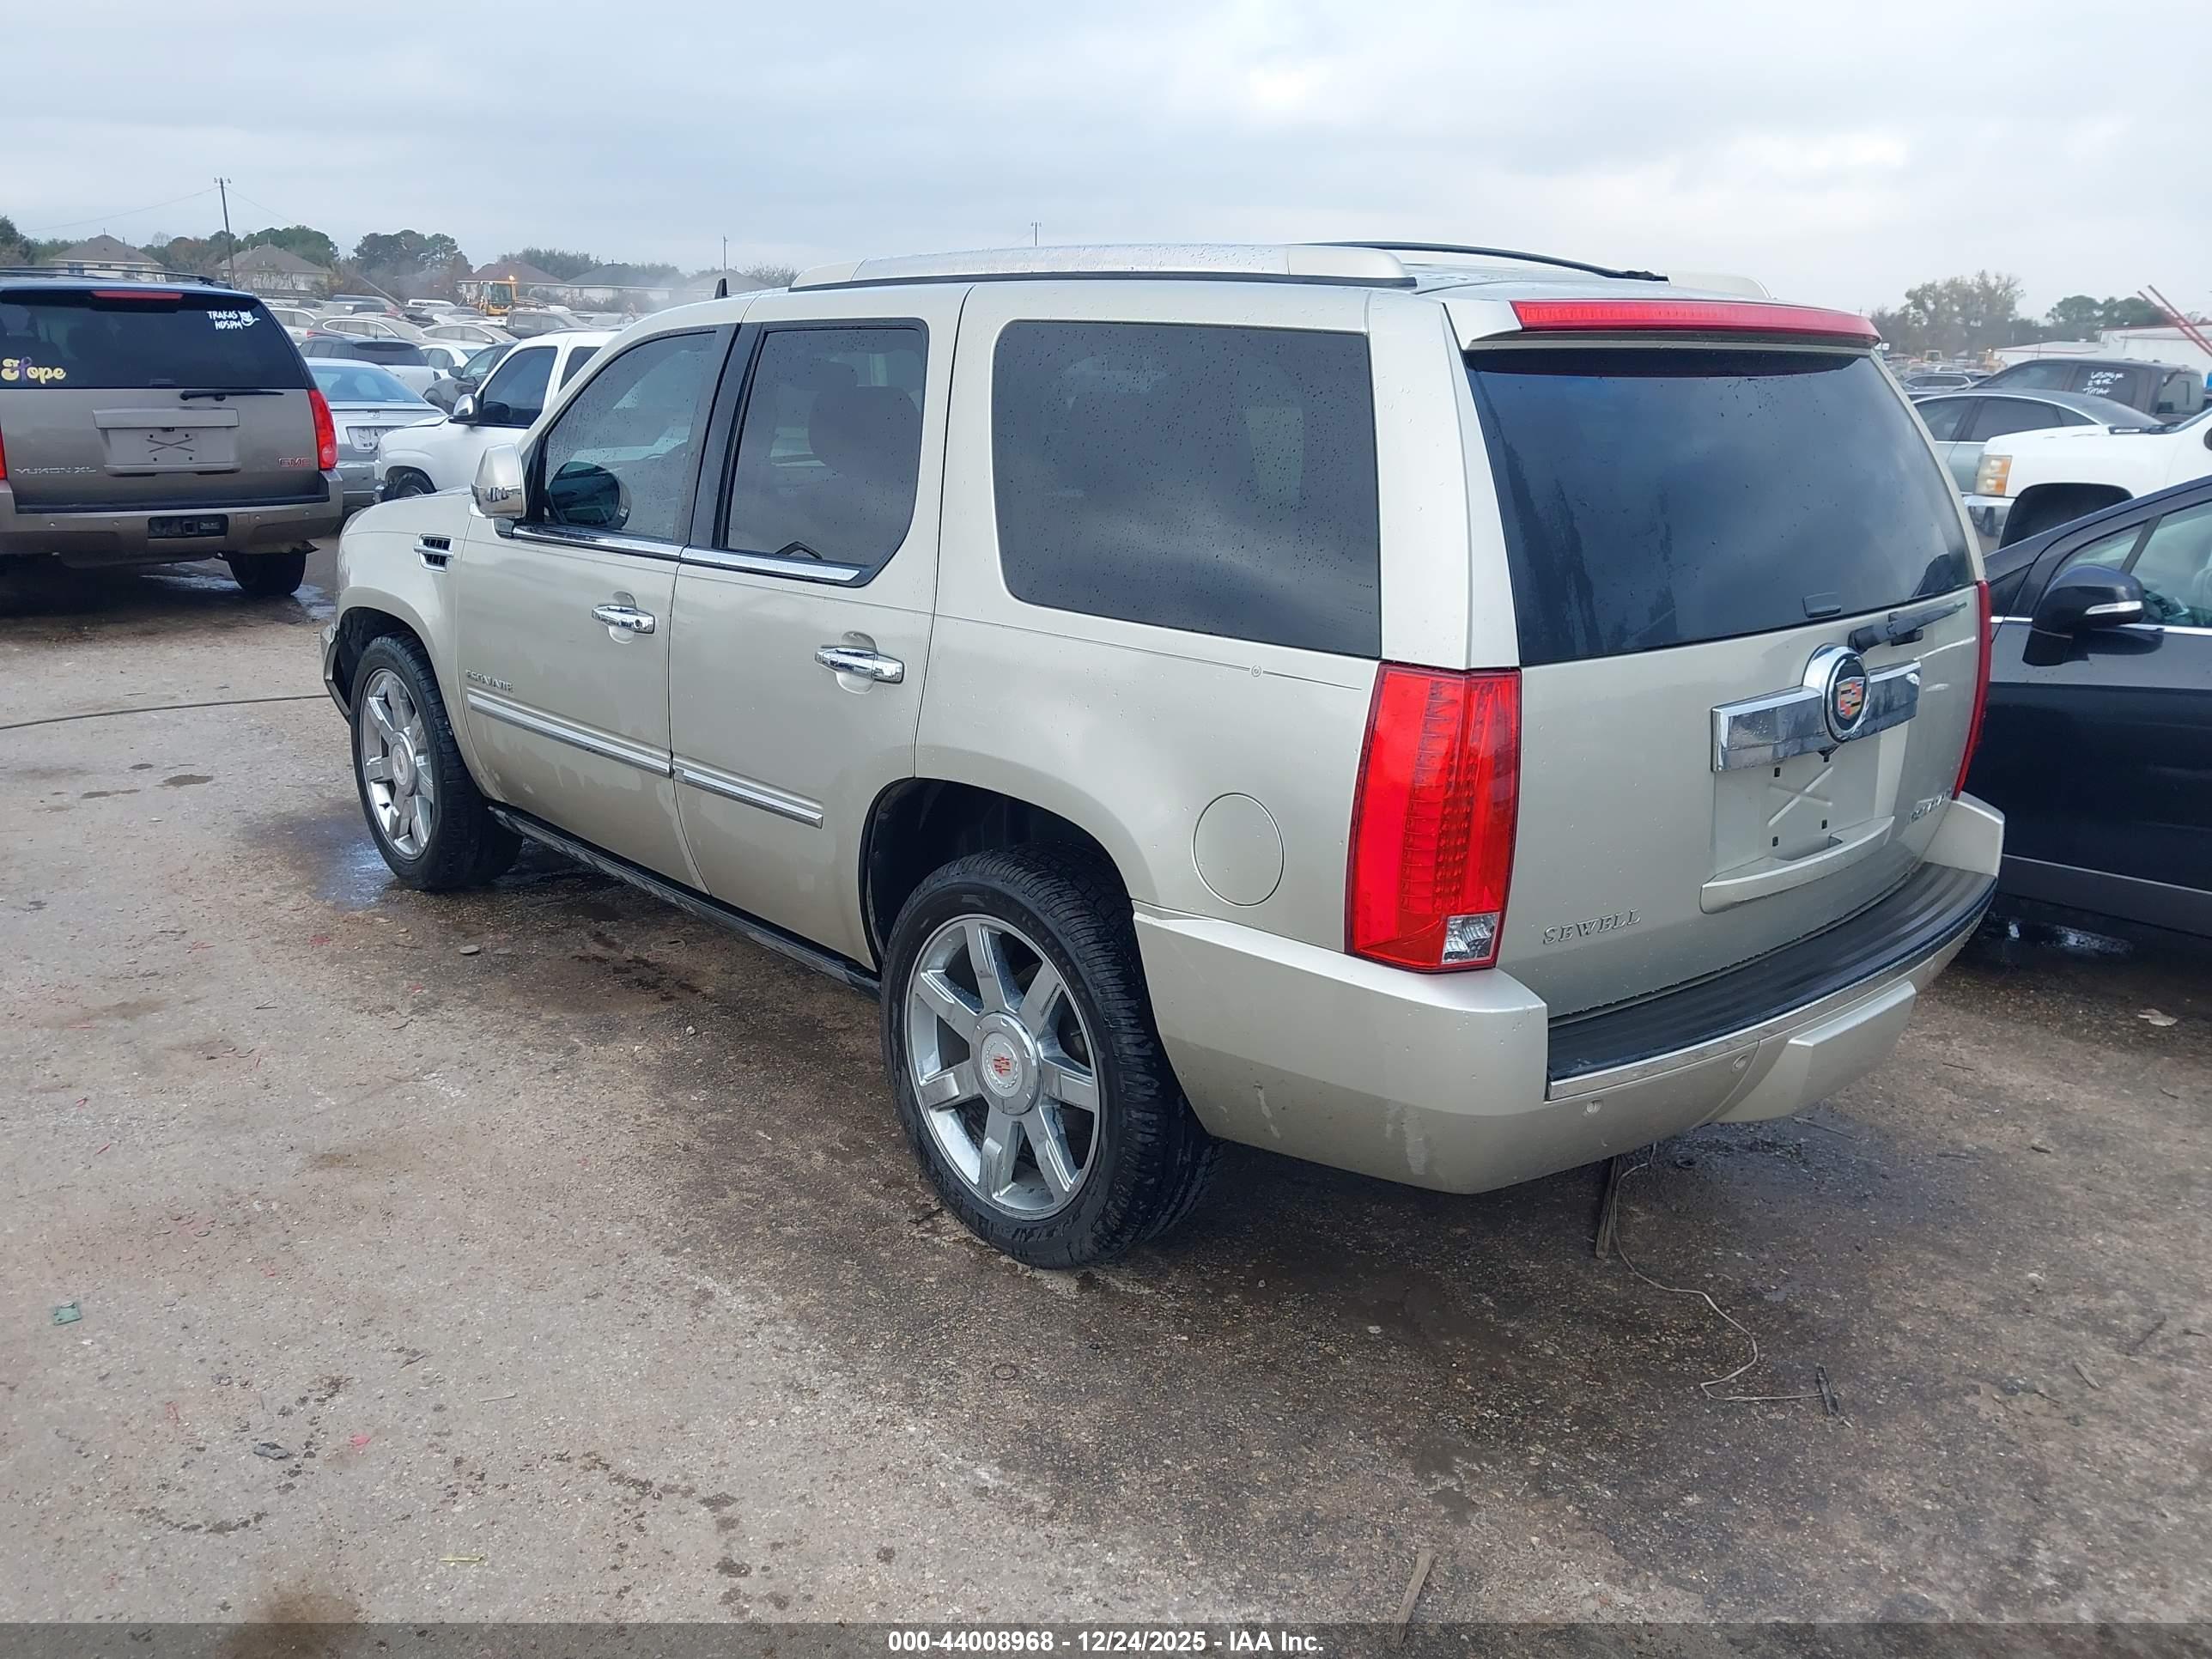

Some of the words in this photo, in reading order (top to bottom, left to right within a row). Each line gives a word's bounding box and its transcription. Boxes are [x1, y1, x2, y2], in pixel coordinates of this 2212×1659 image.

[206, 310, 238, 319] TRAKAS
[278, 457, 311, 467] GMC
[14, 466, 71, 475] YUKON
[1543, 908, 1641, 945] SEWELL
